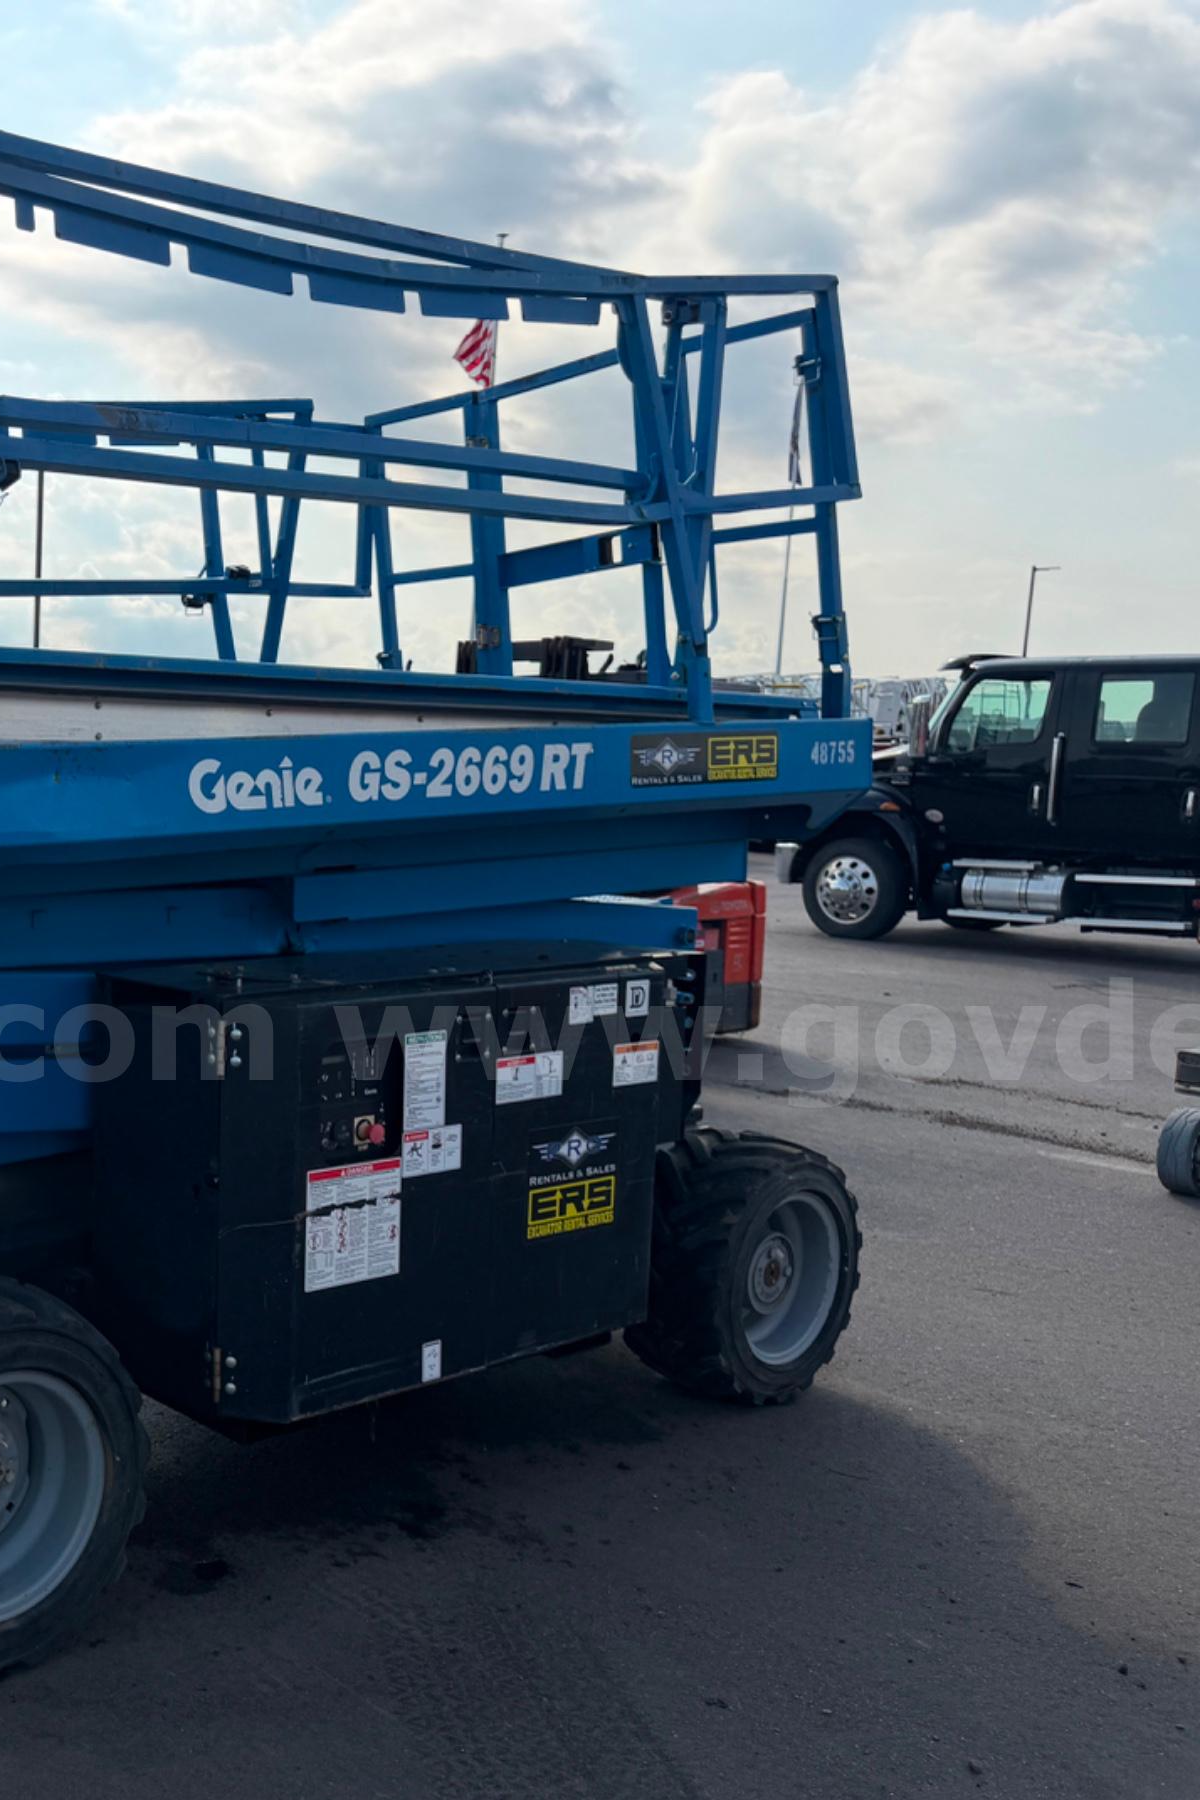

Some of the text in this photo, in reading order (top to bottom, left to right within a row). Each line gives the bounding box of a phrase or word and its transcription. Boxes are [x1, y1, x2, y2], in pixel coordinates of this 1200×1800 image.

[348, 743, 594, 803] GS-2669 RT
[710, 738, 776, 766] ERS
[811, 740, 855, 765] 48755
[188, 755, 324, 814] Genie
[531, 1178, 614, 1222] ERS
